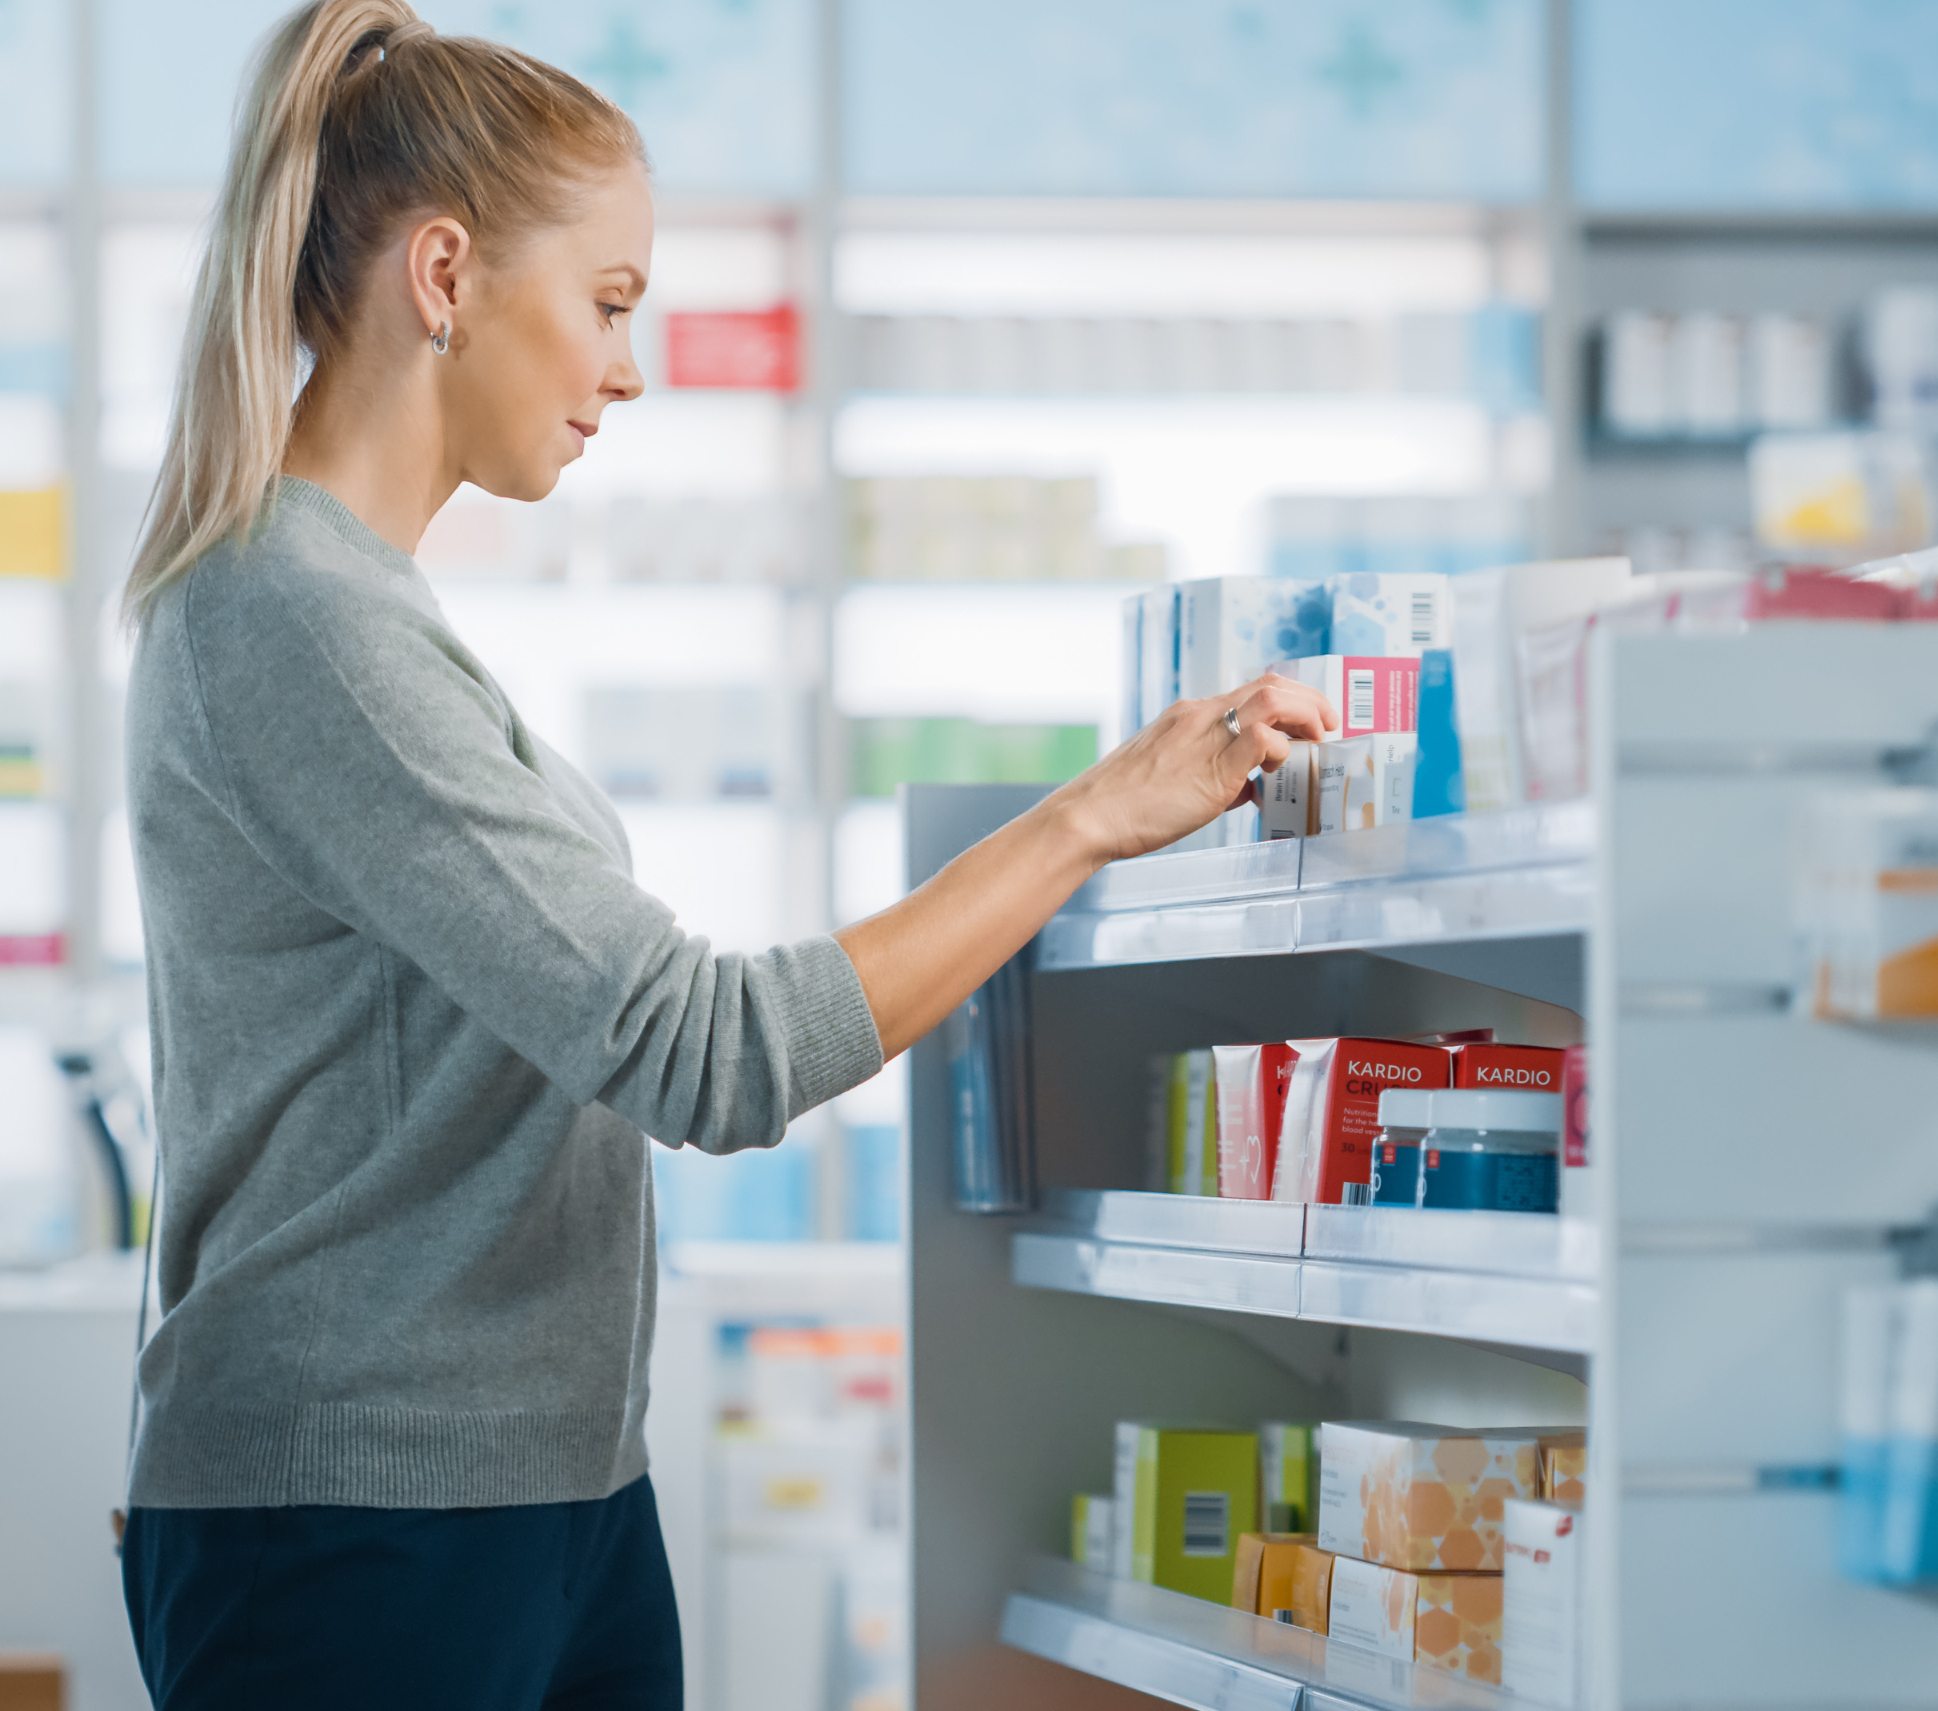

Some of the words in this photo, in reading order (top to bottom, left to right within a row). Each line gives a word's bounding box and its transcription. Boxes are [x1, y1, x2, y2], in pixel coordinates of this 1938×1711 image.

[1275, 782, 1283, 802] Brain
[1348, 1060, 1422, 1082] KARDIO
[1477, 1066, 1551, 1085] KARDIO
[1344, 1108, 1379, 1118] Nutrition
[1343, 1116, 1354, 1124] for
[1356, 1118, 1368, 1126] the
[1342, 1126, 1364, 1134] blood
[1342, 1142, 1355, 1153] 30
